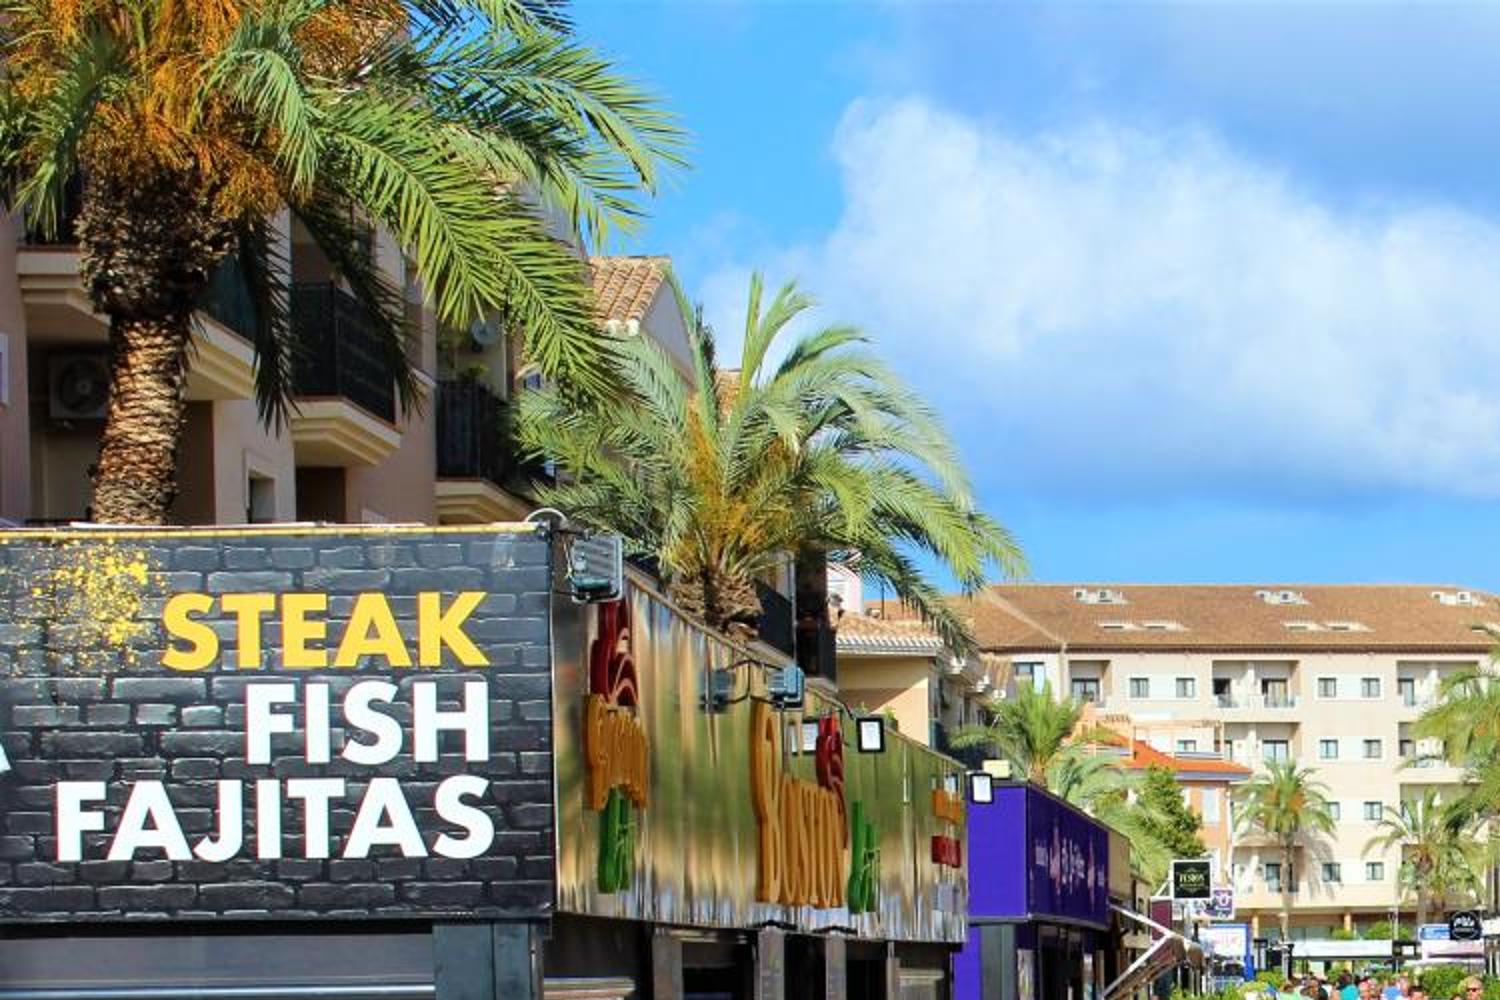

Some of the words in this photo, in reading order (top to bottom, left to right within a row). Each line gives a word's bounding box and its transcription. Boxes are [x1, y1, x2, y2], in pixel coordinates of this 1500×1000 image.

[161, 591, 490, 671] STEAK
[245, 680, 490, 765] FISH
[56, 774, 496, 863] FAJITAS
